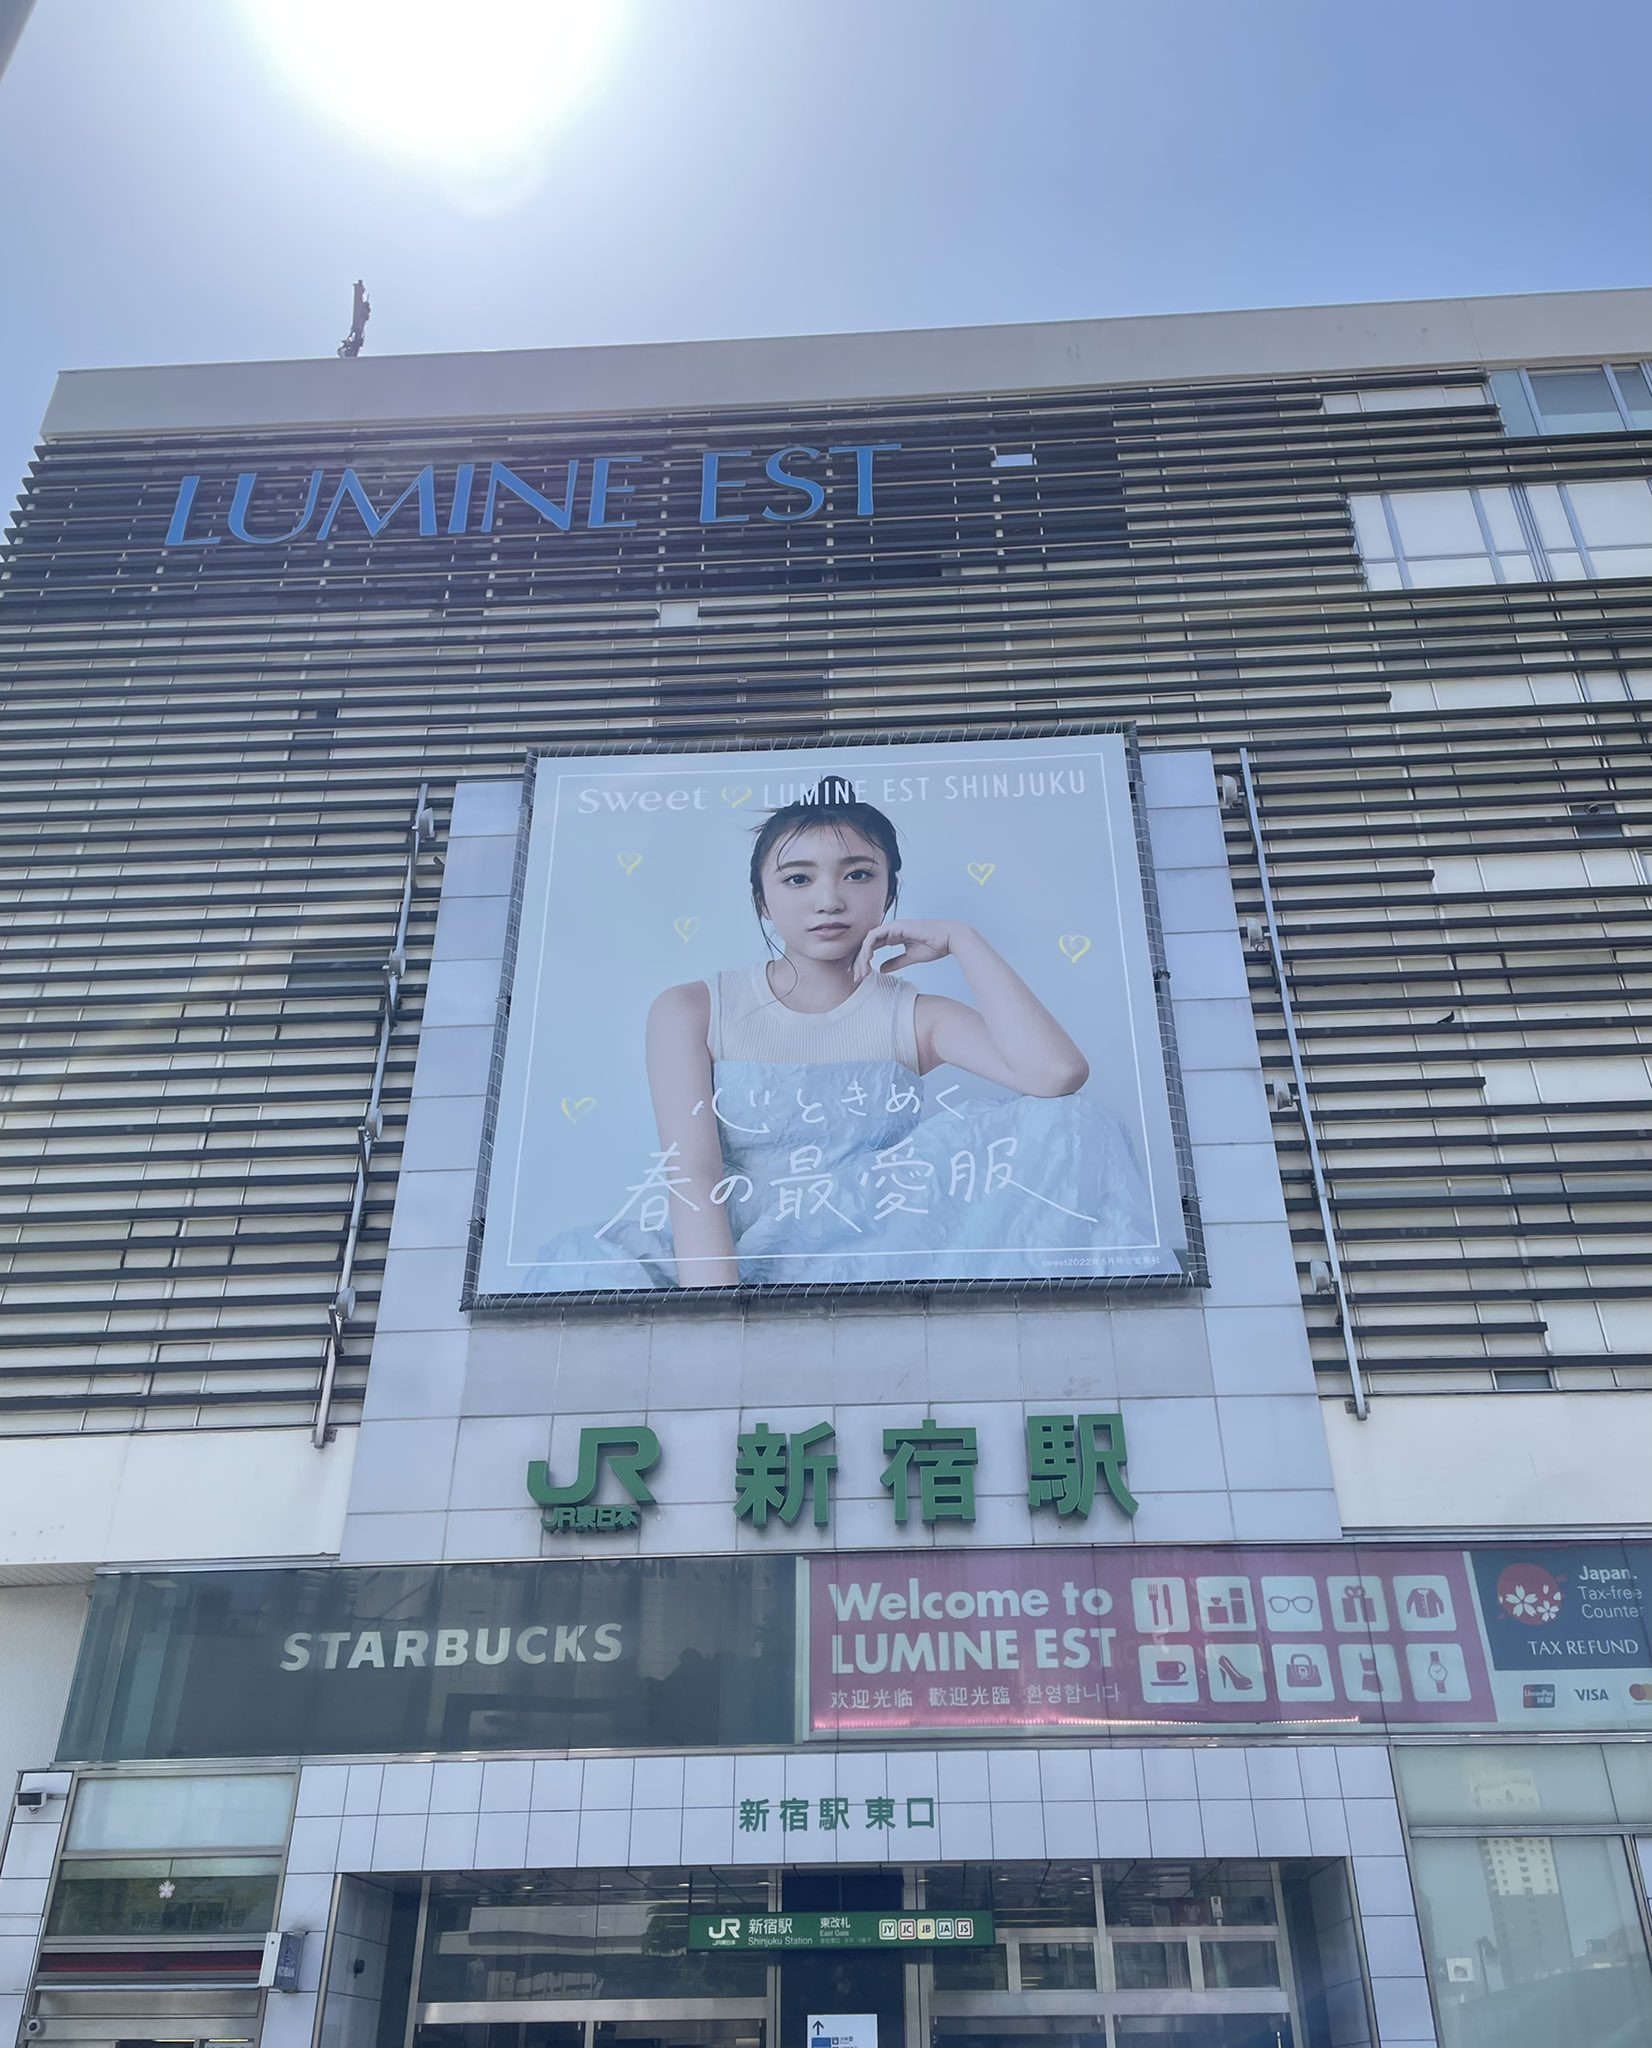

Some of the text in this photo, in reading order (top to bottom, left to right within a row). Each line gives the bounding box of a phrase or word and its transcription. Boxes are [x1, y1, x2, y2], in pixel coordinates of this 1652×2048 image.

[165, 443, 902, 546] LUMINE EST
[764, 780, 867, 808] LUMINE
[884, 777, 930, 802] EST
[945, 769, 1086, 799] SHINJUKU
[692, 1080, 966, 1134] 心ときめく
[594, 1135, 1098, 1240] 春の最愛服
[527, 1413, 1139, 1528] JR 新宿駅
[541, 1505, 639, 1532] JR東日本
[828, 1578, 1113, 1621] Welcome to
[1577, 1585, 1643, 1600] Tax-free
[280, 1623, 623, 1671] STARBUCKS
[832, 1627, 1117, 1674] LUMINE EST
[1528, 1639, 1639, 1655] TAX REFUND
[830, 1683, 1120, 1710] 欢迎光临 歡迎光臨 환영합니다
[1574, 1688, 1609, 1701] VISA
[708, 1918, 741, 1939] JR
[748, 1918, 793, 1934] 新宿駅
[820, 1917, 850, 1929] 東改札
[883, 1923, 968, 1934] JY JC JB JA JS
[748, 1936, 782, 1947] Shinjuku
[784, 1936, 813, 1945] Station
